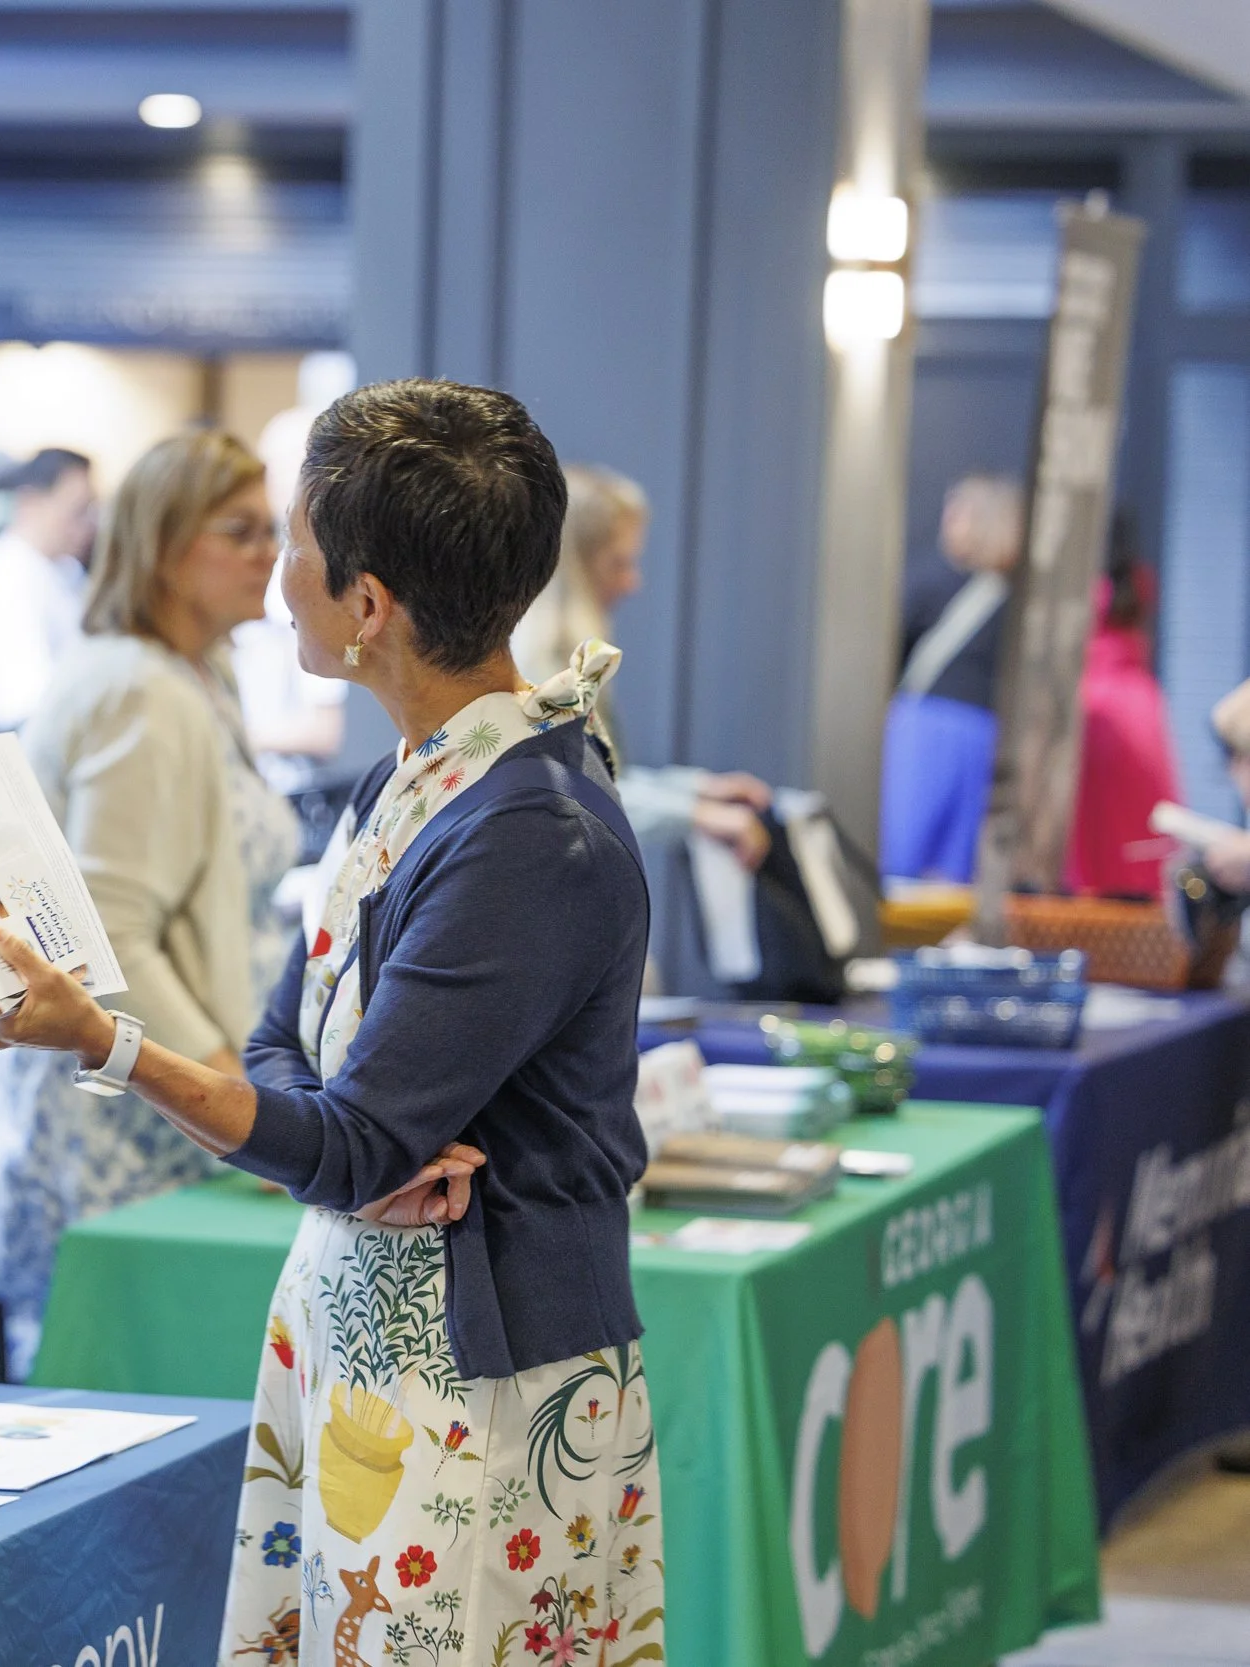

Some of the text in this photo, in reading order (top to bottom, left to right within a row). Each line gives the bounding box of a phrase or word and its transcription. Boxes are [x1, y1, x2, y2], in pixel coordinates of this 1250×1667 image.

[30, 881, 75, 955] Navigators
[40, 878, 73, 932] GEORGIA
[36, 912, 65, 959] Patient
